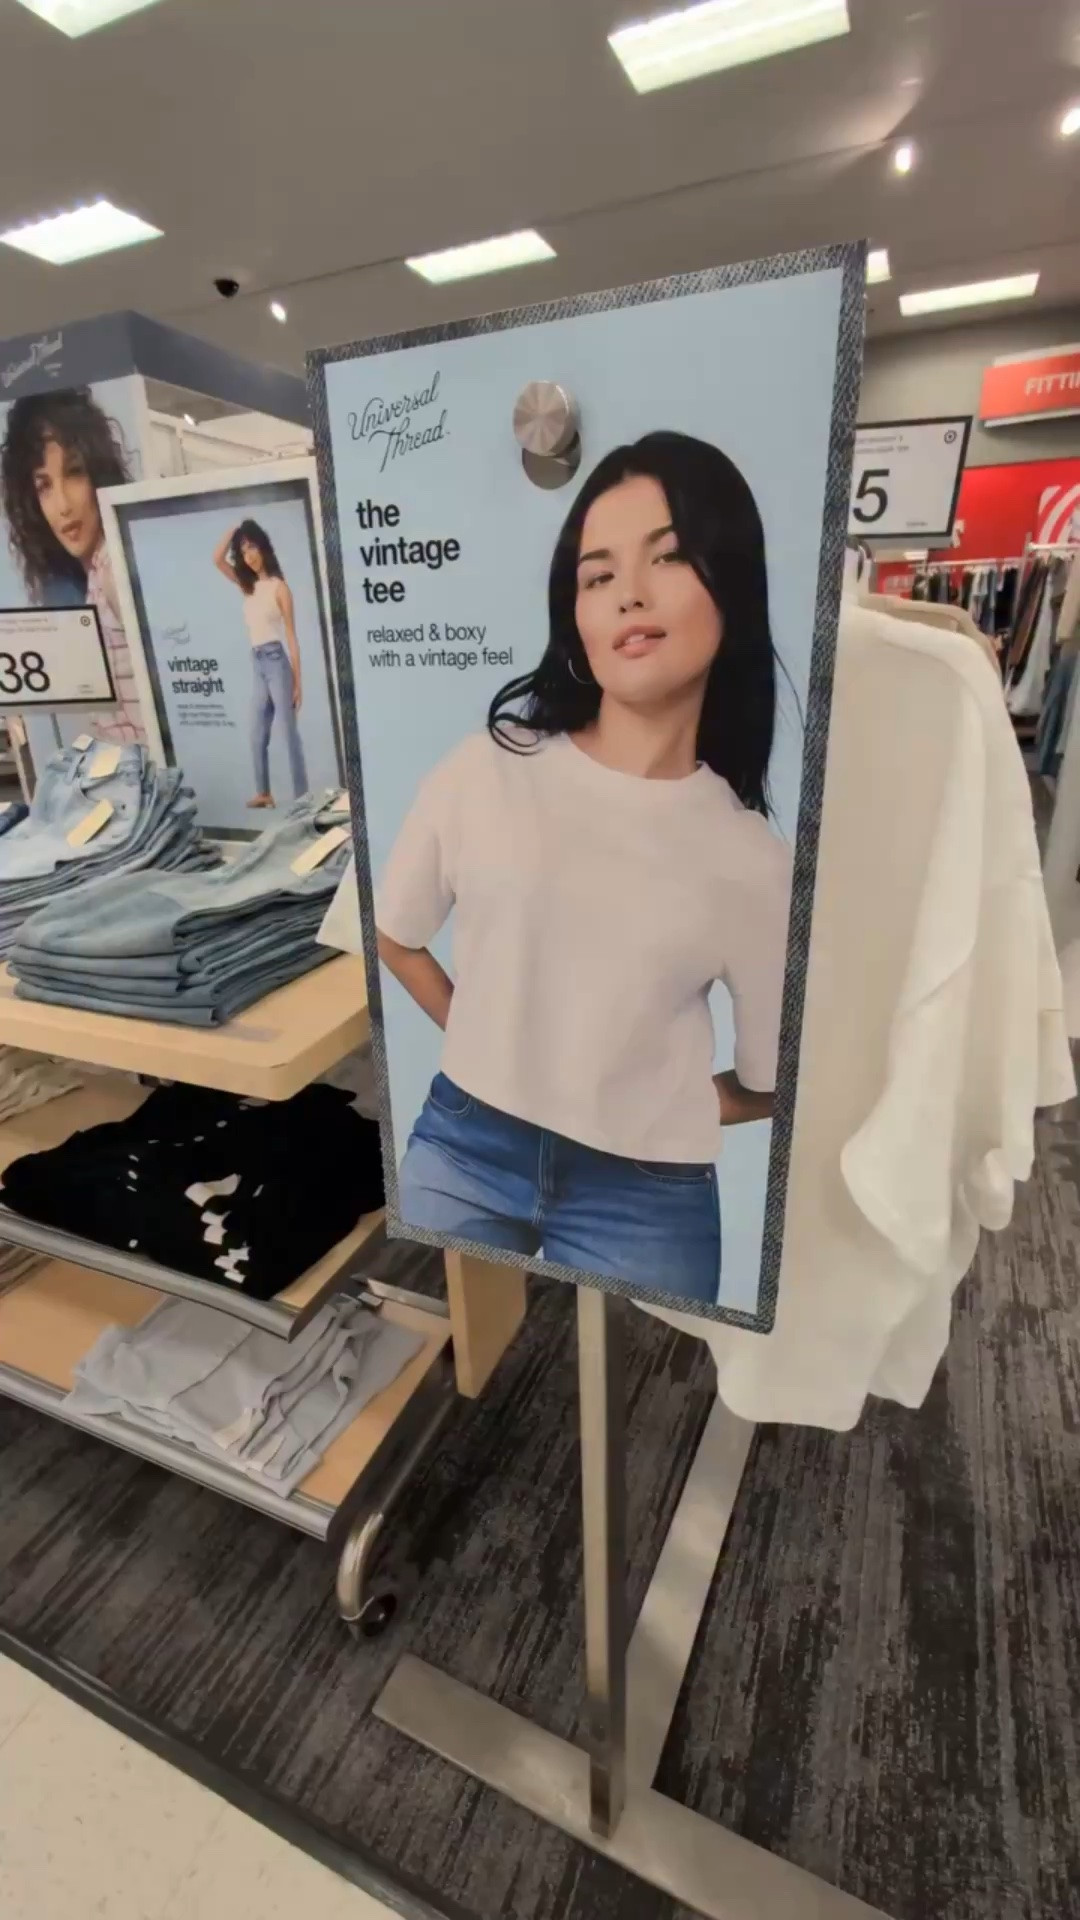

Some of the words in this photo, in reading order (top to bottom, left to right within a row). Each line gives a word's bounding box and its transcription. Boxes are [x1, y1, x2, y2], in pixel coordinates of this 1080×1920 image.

[347, 370, 441, 441] Universal
[367, 408, 447, 473] Thread
[356, 499, 400, 529] the
[360, 537, 461, 570] vintage
[362, 577, 406, 604] tee
[366, 623, 424, 643] relaxed
[428, 622, 442, 642] &
[444, 622, 487, 645] boxy
[167, 656, 219, 676] vintage
[368, 649, 401, 668] with
[405, 652, 416, 667] a
[418, 648, 478, 671] vintage
[482, 646, 514, 666] feel
[171, 677, 226, 698] straight
